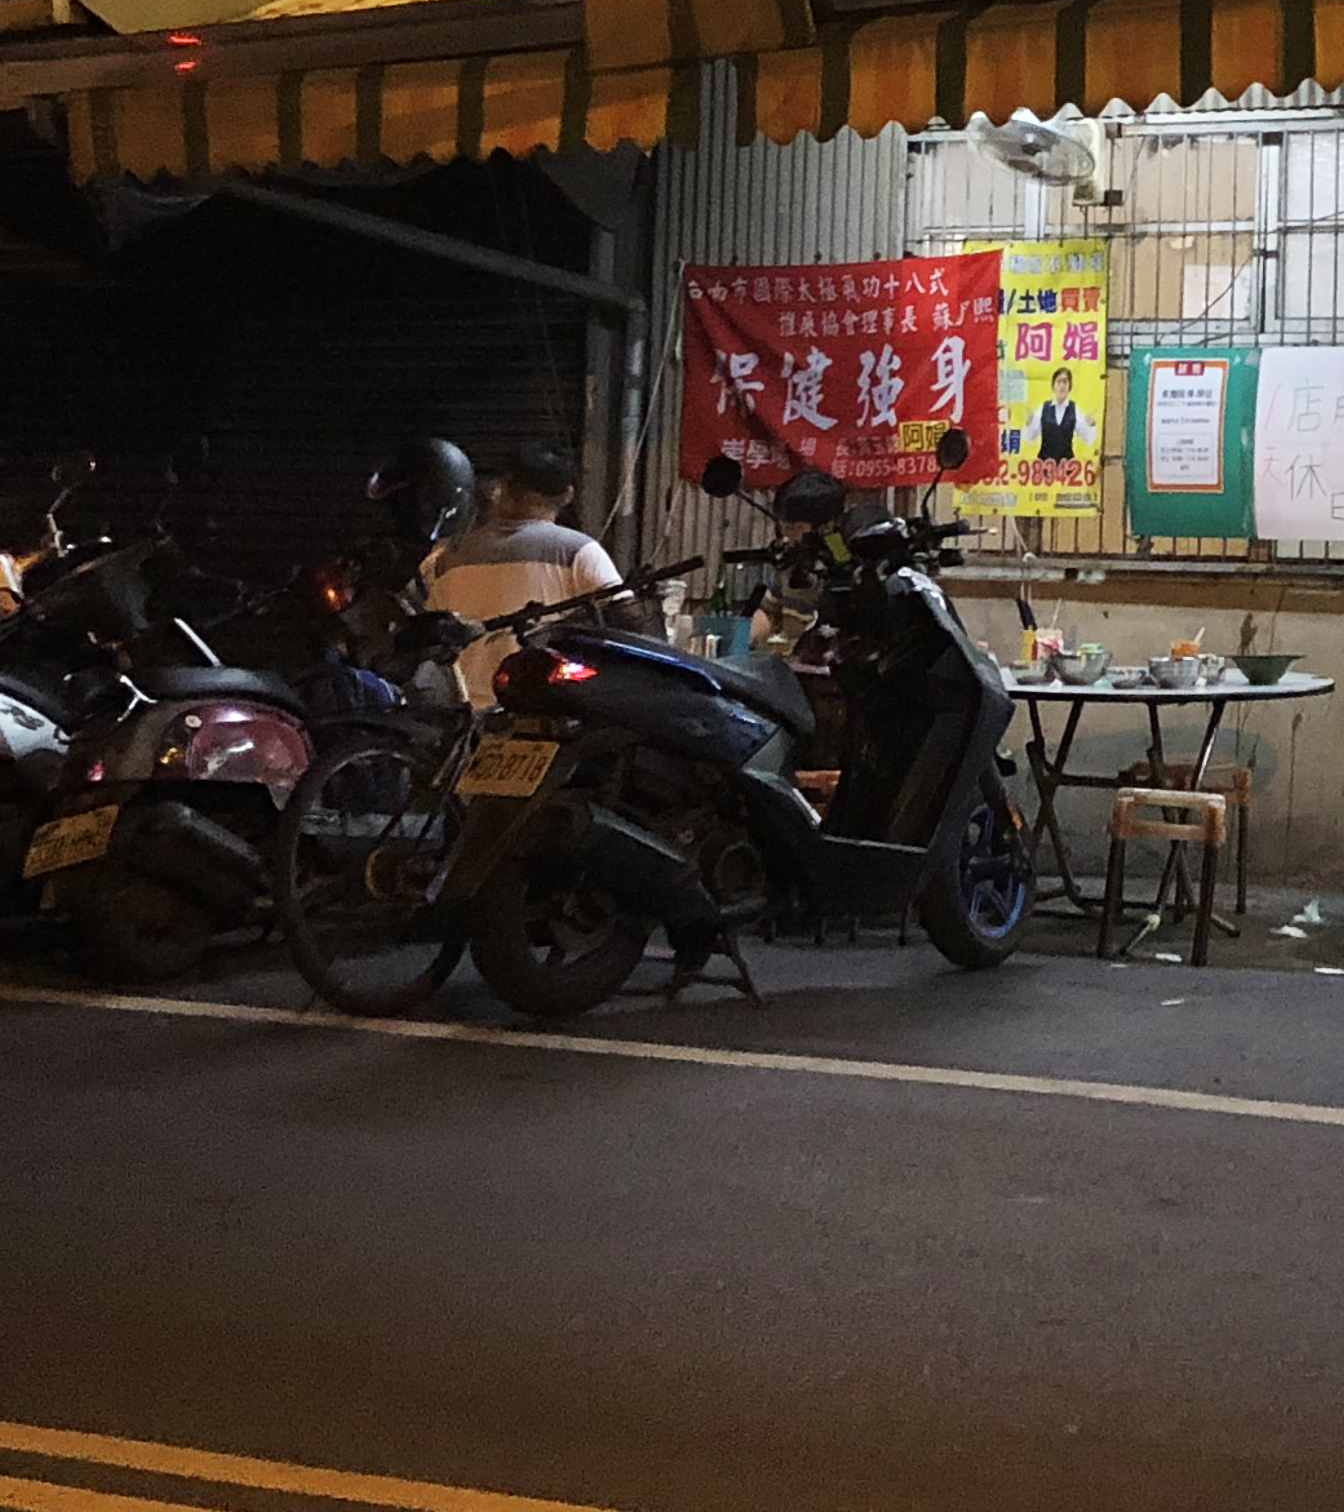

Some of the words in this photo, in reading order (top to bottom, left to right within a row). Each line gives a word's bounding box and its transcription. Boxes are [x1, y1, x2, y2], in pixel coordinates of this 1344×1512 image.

[1014, 320, 1100, 362] 阿娟
[709, 335, 971, 431] 保健強身
